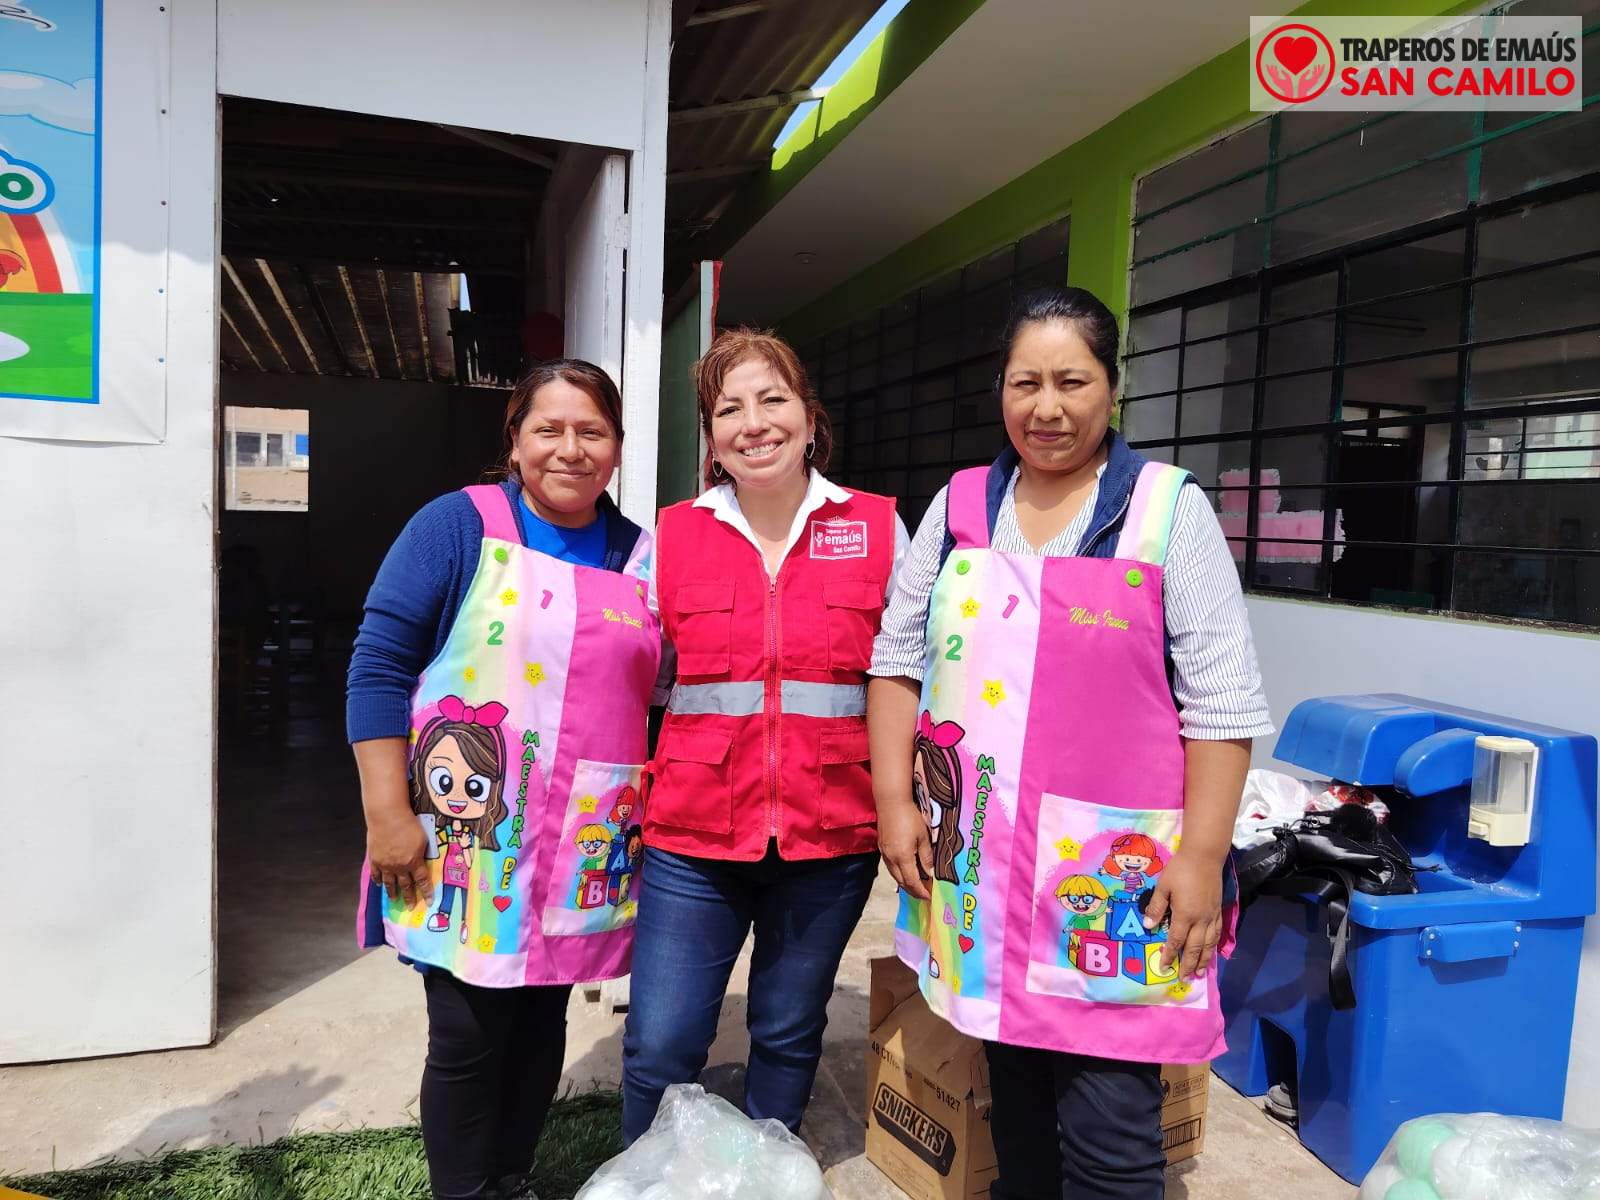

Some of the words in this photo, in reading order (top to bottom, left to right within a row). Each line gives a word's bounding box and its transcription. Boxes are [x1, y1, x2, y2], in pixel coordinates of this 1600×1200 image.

[825, 530, 862, 545] emaús
[540, 589, 553, 609] 1
[1002, 594, 1019, 619] 1
[1069, 607, 1097, 624] Miss
[487, 621, 505, 645] 2
[945, 634, 963, 661] 2
[507, 729, 540, 849] MAESTRA
[964, 754, 996, 886] MAESTRA
[611, 848, 625, 872] A
[501, 857, 517, 890] DE
[586, 880, 603, 905] B
[962, 892, 977, 931] DE
[1117, 906, 1145, 938] A
[1085, 942, 1111, 973] B
[871, 1041, 880, 1056] 48
[936, 1086, 961, 1112] 51427
[878, 1088, 945, 1154] SNICKERS
